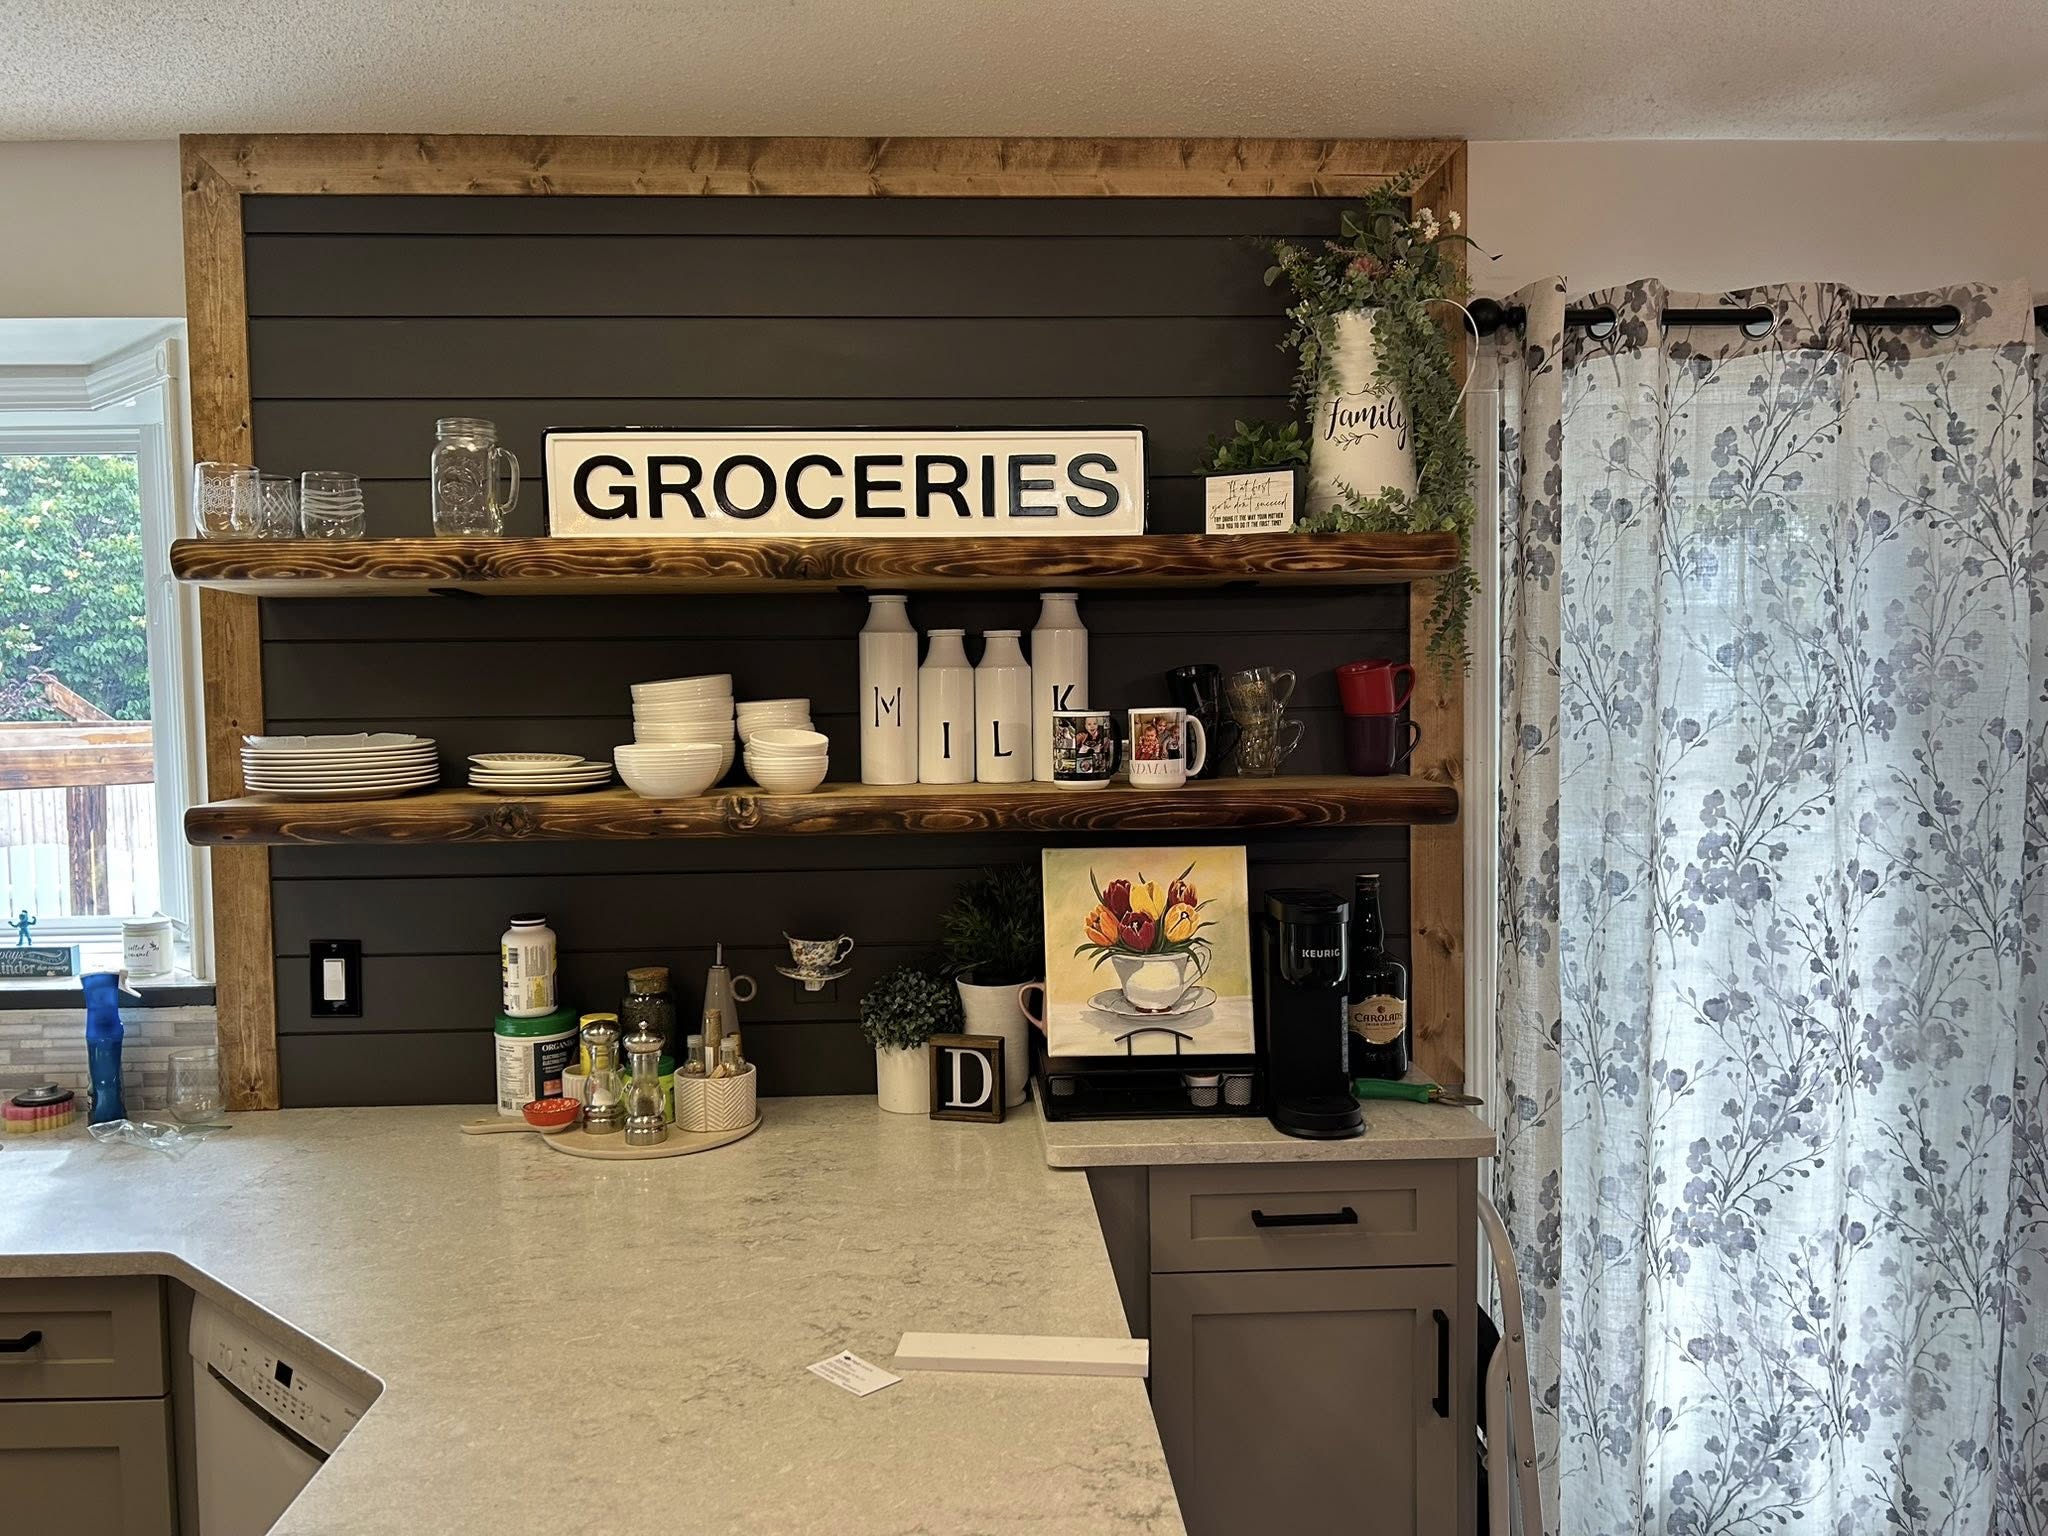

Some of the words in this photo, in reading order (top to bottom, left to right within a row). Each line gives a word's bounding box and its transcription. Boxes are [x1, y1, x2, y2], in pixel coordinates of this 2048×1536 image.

[1323, 396, 1410, 451] Family
[572, 452, 1119, 519] GROCERIES
[874, 686, 901, 727] M
[1053, 684, 1076, 710] K
[943, 722, 951, 759] I
[992, 720, 1013, 757] L
[0, 961, 35, 975] inder
[1302, 948, 1341, 958] KEURIG
[944, 1048, 993, 1108] D
